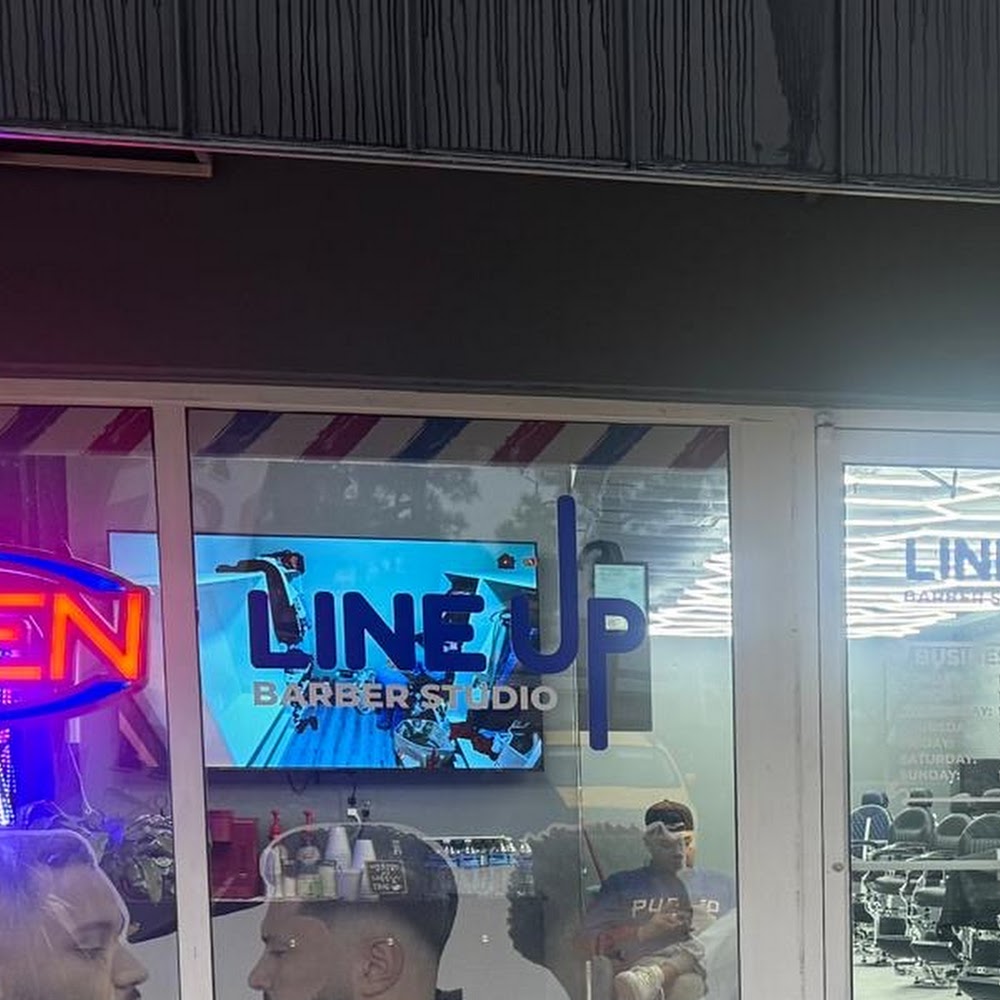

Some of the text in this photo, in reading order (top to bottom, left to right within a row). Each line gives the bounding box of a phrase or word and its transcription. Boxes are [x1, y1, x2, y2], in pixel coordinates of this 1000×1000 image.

[247, 494, 647, 751] LINE UP
[253, 681, 559, 711] BARBER STUDIO
[900, 769, 961, 780] UNDAY:
